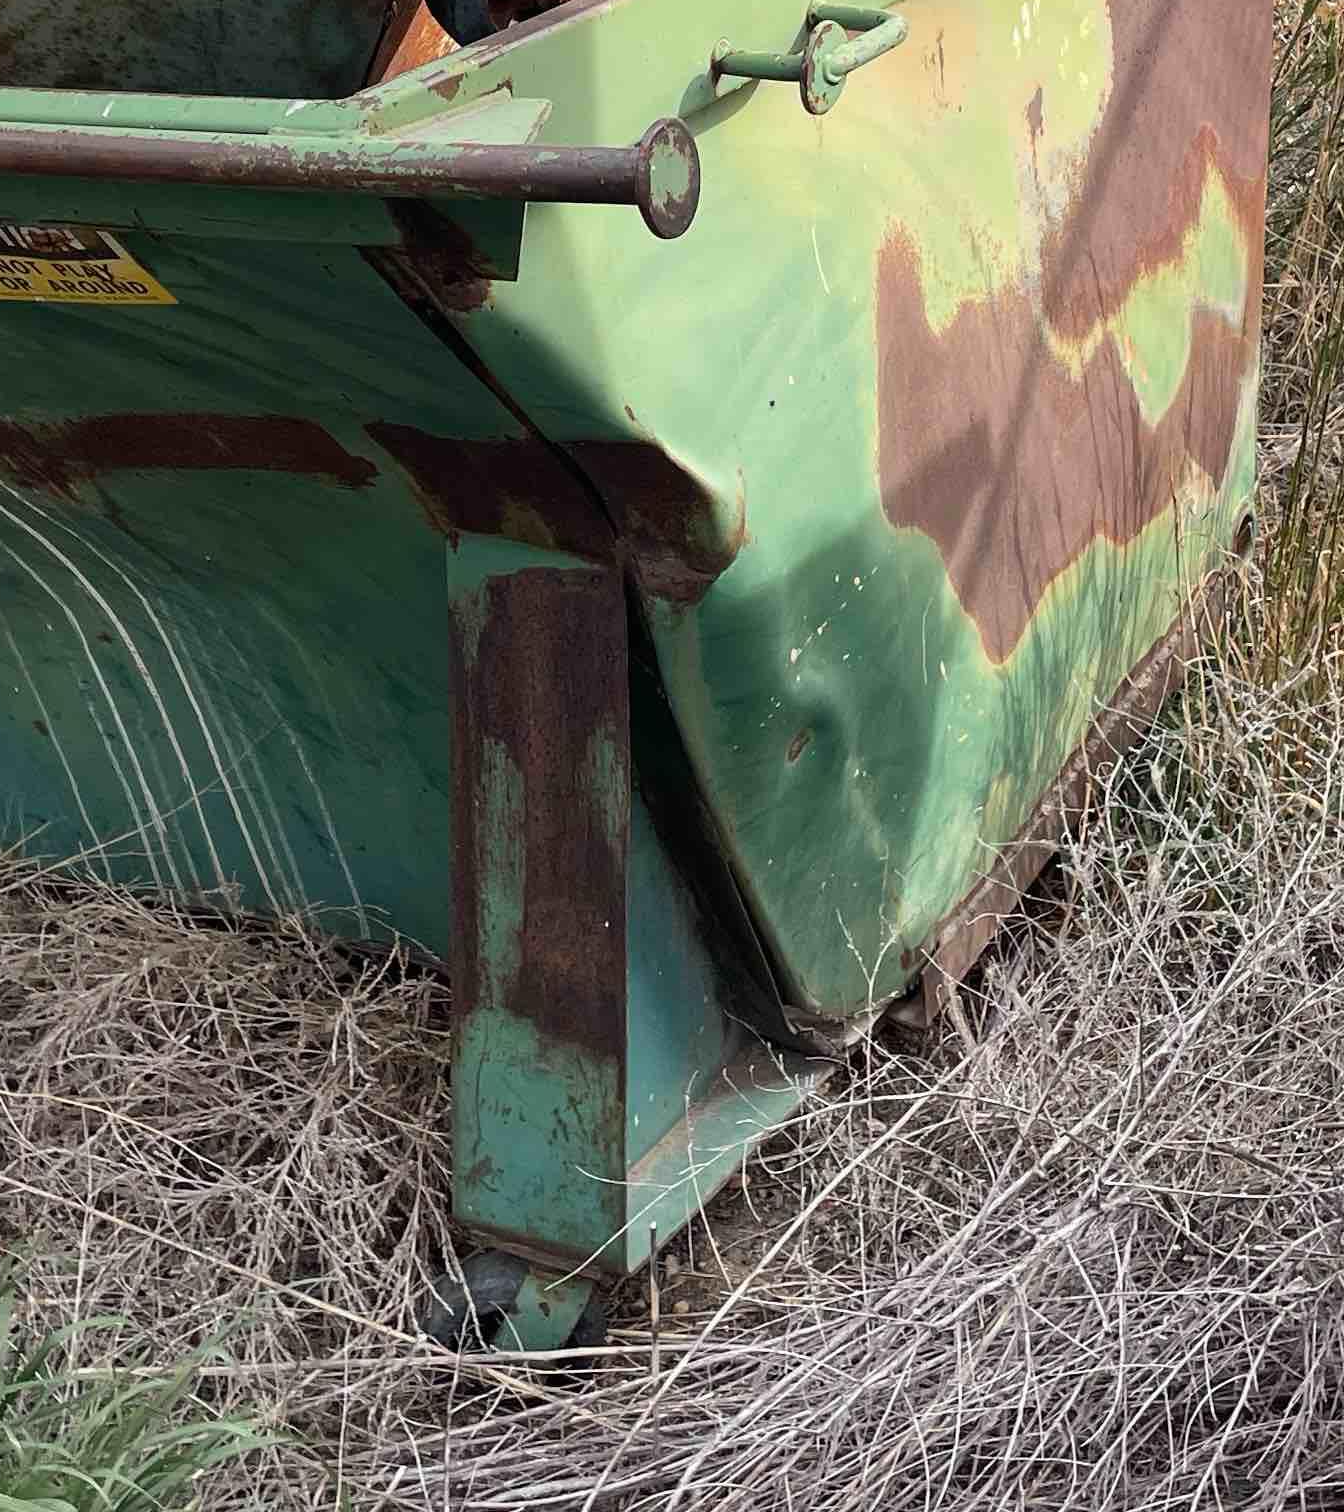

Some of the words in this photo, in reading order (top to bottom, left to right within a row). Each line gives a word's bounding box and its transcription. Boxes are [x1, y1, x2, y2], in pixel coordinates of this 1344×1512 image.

[51, 263, 114, 282] PLAY
[0, 276, 34, 292] OR
[47, 278, 150, 296] AROUND
